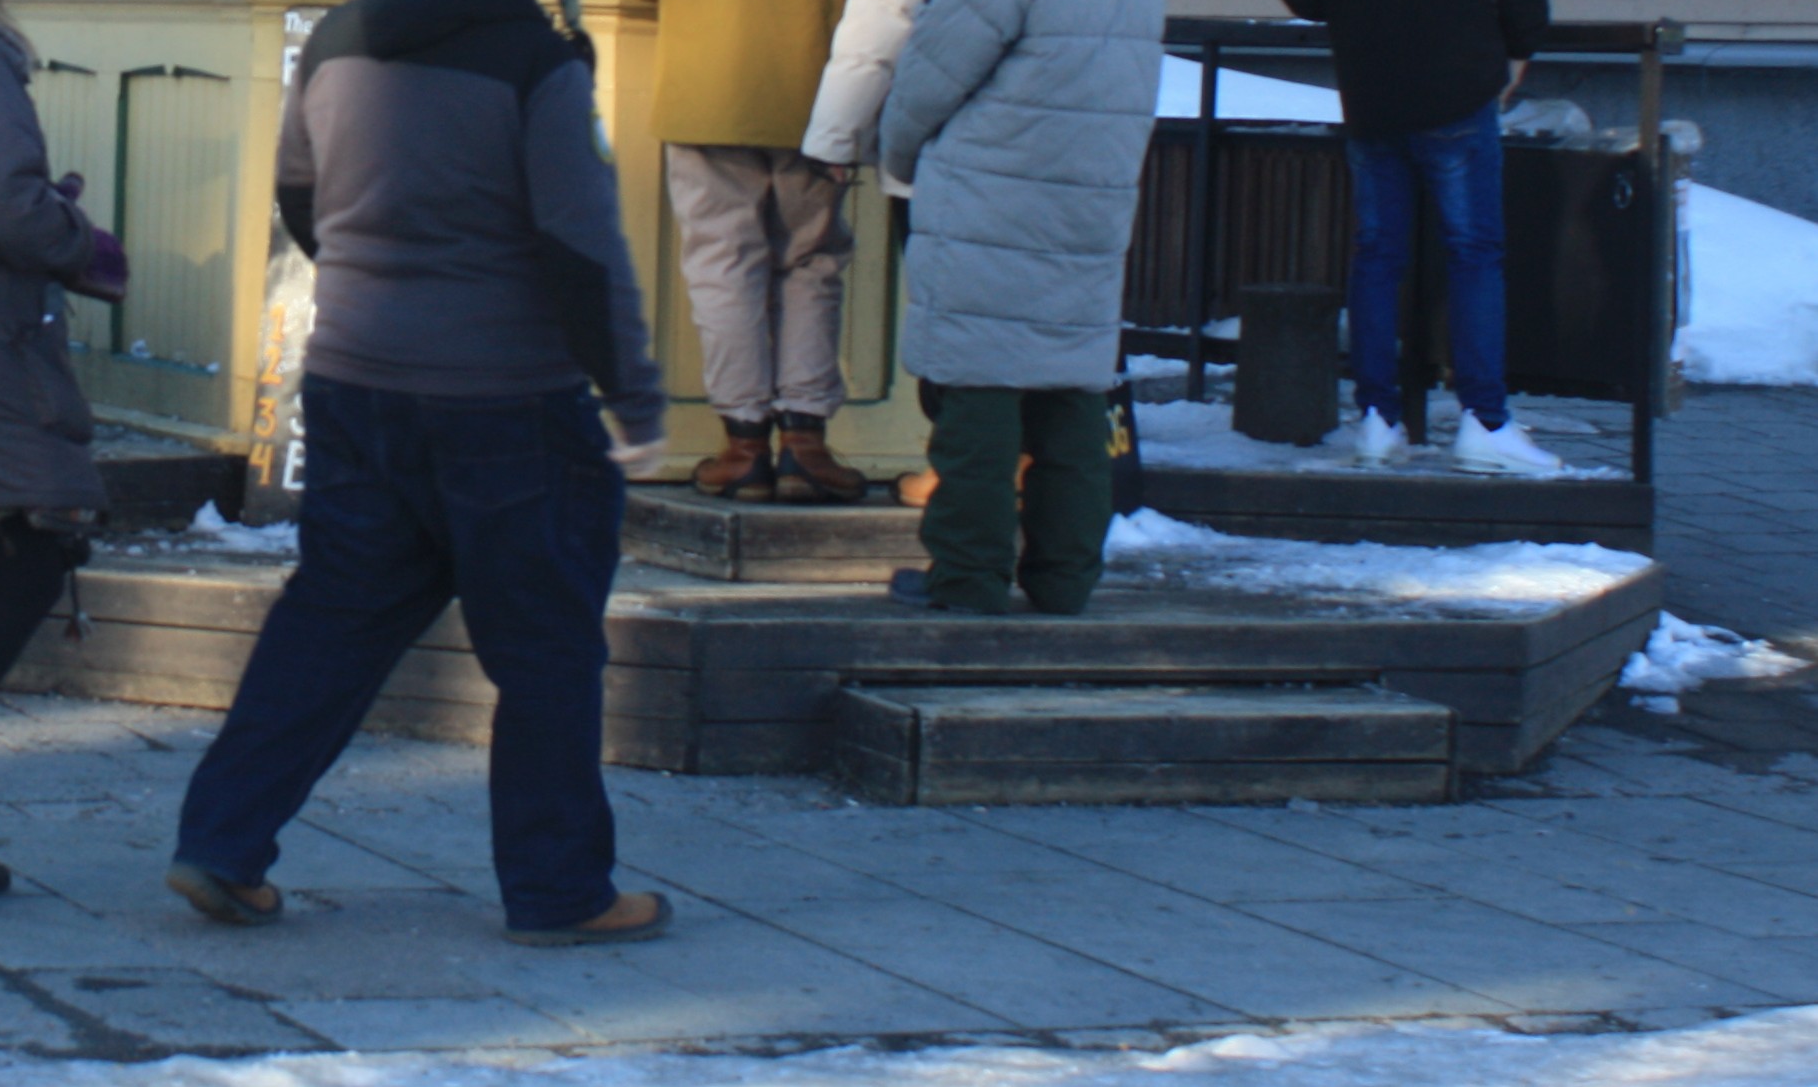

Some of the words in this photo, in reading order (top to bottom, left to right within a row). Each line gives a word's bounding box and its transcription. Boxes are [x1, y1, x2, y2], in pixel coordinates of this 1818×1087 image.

[270, 302, 287, 342] 1
[260, 345, 284, 386] 2
[254, 397, 278, 438] 3
[249, 442, 275, 486] 4
